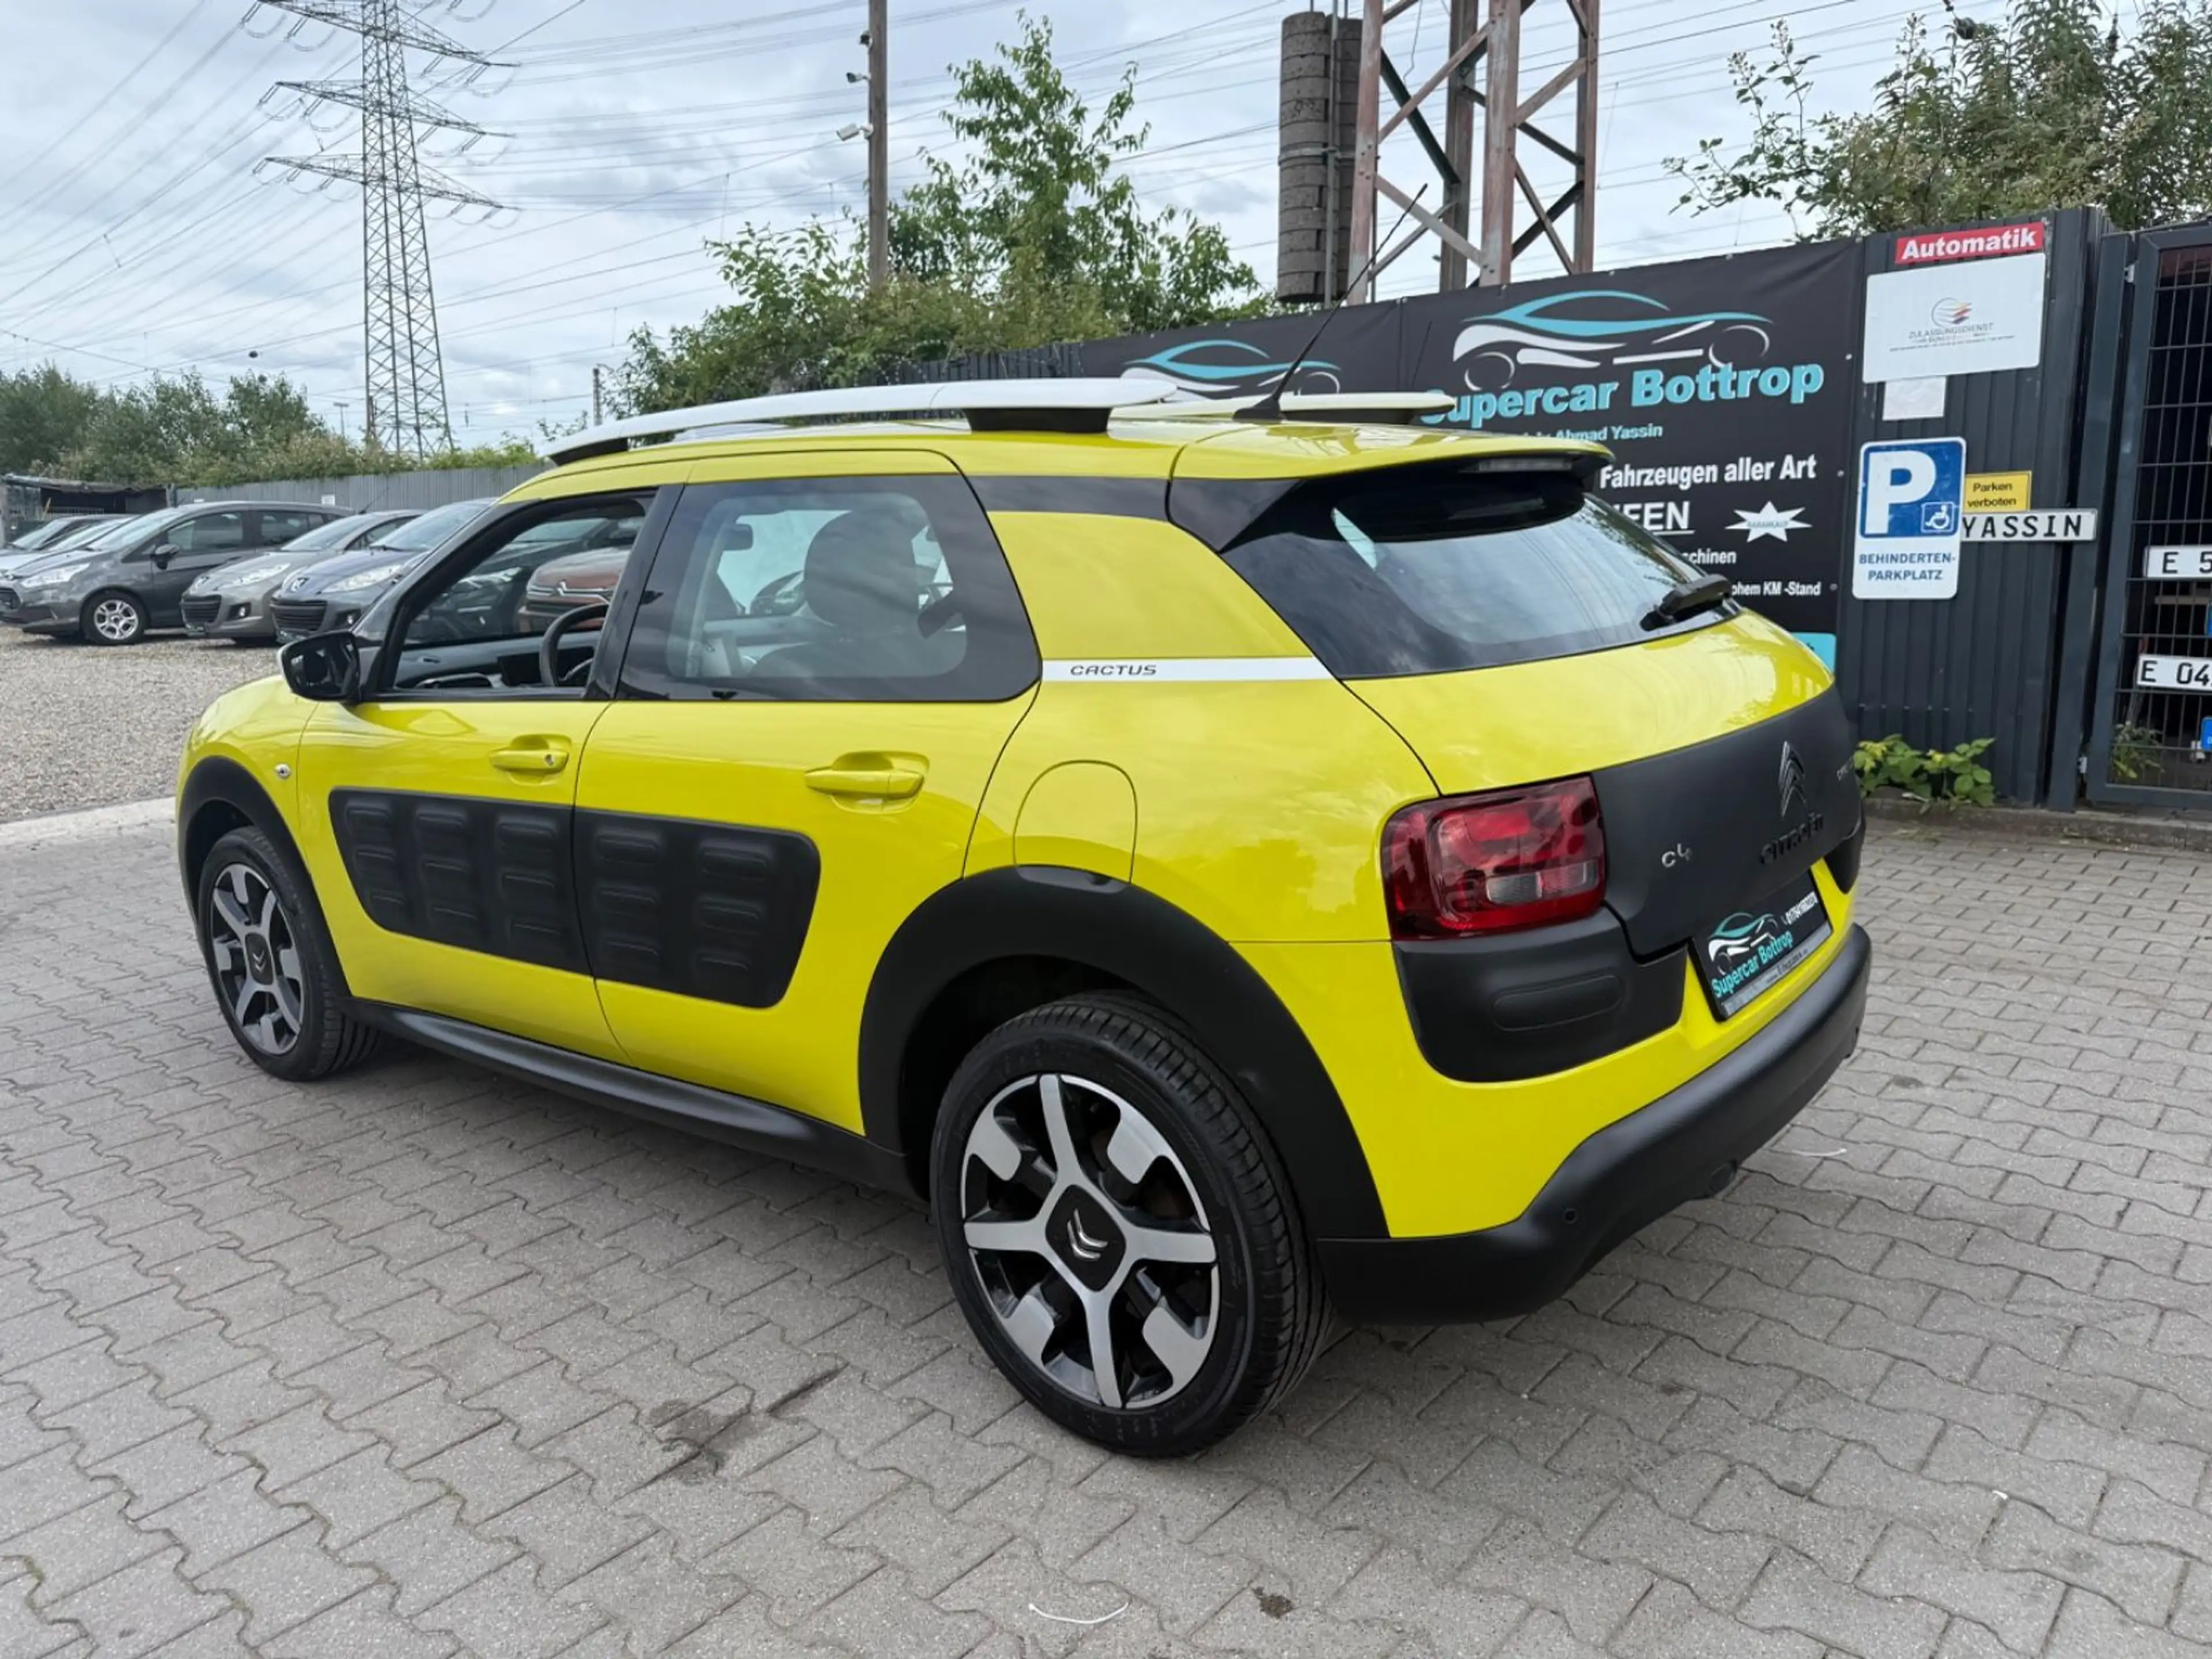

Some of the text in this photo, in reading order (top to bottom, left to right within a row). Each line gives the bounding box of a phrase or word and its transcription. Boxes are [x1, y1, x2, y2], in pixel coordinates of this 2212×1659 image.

[1902, 228, 2037, 259] Automatik
[1631, 362, 1824, 407] Bottrop
[1611, 423, 1663, 440] Yassin
[1600, 454, 1817, 490] Fahrzeugen aller Art
[1865, 450, 1937, 535] P
[1973, 482, 2013, 493] Parken
[1967, 497, 2017, 508] verboten
[1613, 501, 1690, 531] FEN
[1962, 513, 2081, 538] YASSIN
[1681, 547, 1737, 564] chinen
[1859, 552, 1956, 565] BEHINDERTEN-
[2162, 551, 2179, 574] E
[1868, 569, 1943, 581] PARKPLATZ
[1763, 581, 1782, 596] KM
[1070, 664, 1157, 676] CACTUS
[2140, 660, 2212, 686] E 04
[1661, 843, 1692, 868] C4
[1711, 955, 1760, 998] Supercar
[1758, 930, 1793, 965] Bottrop
